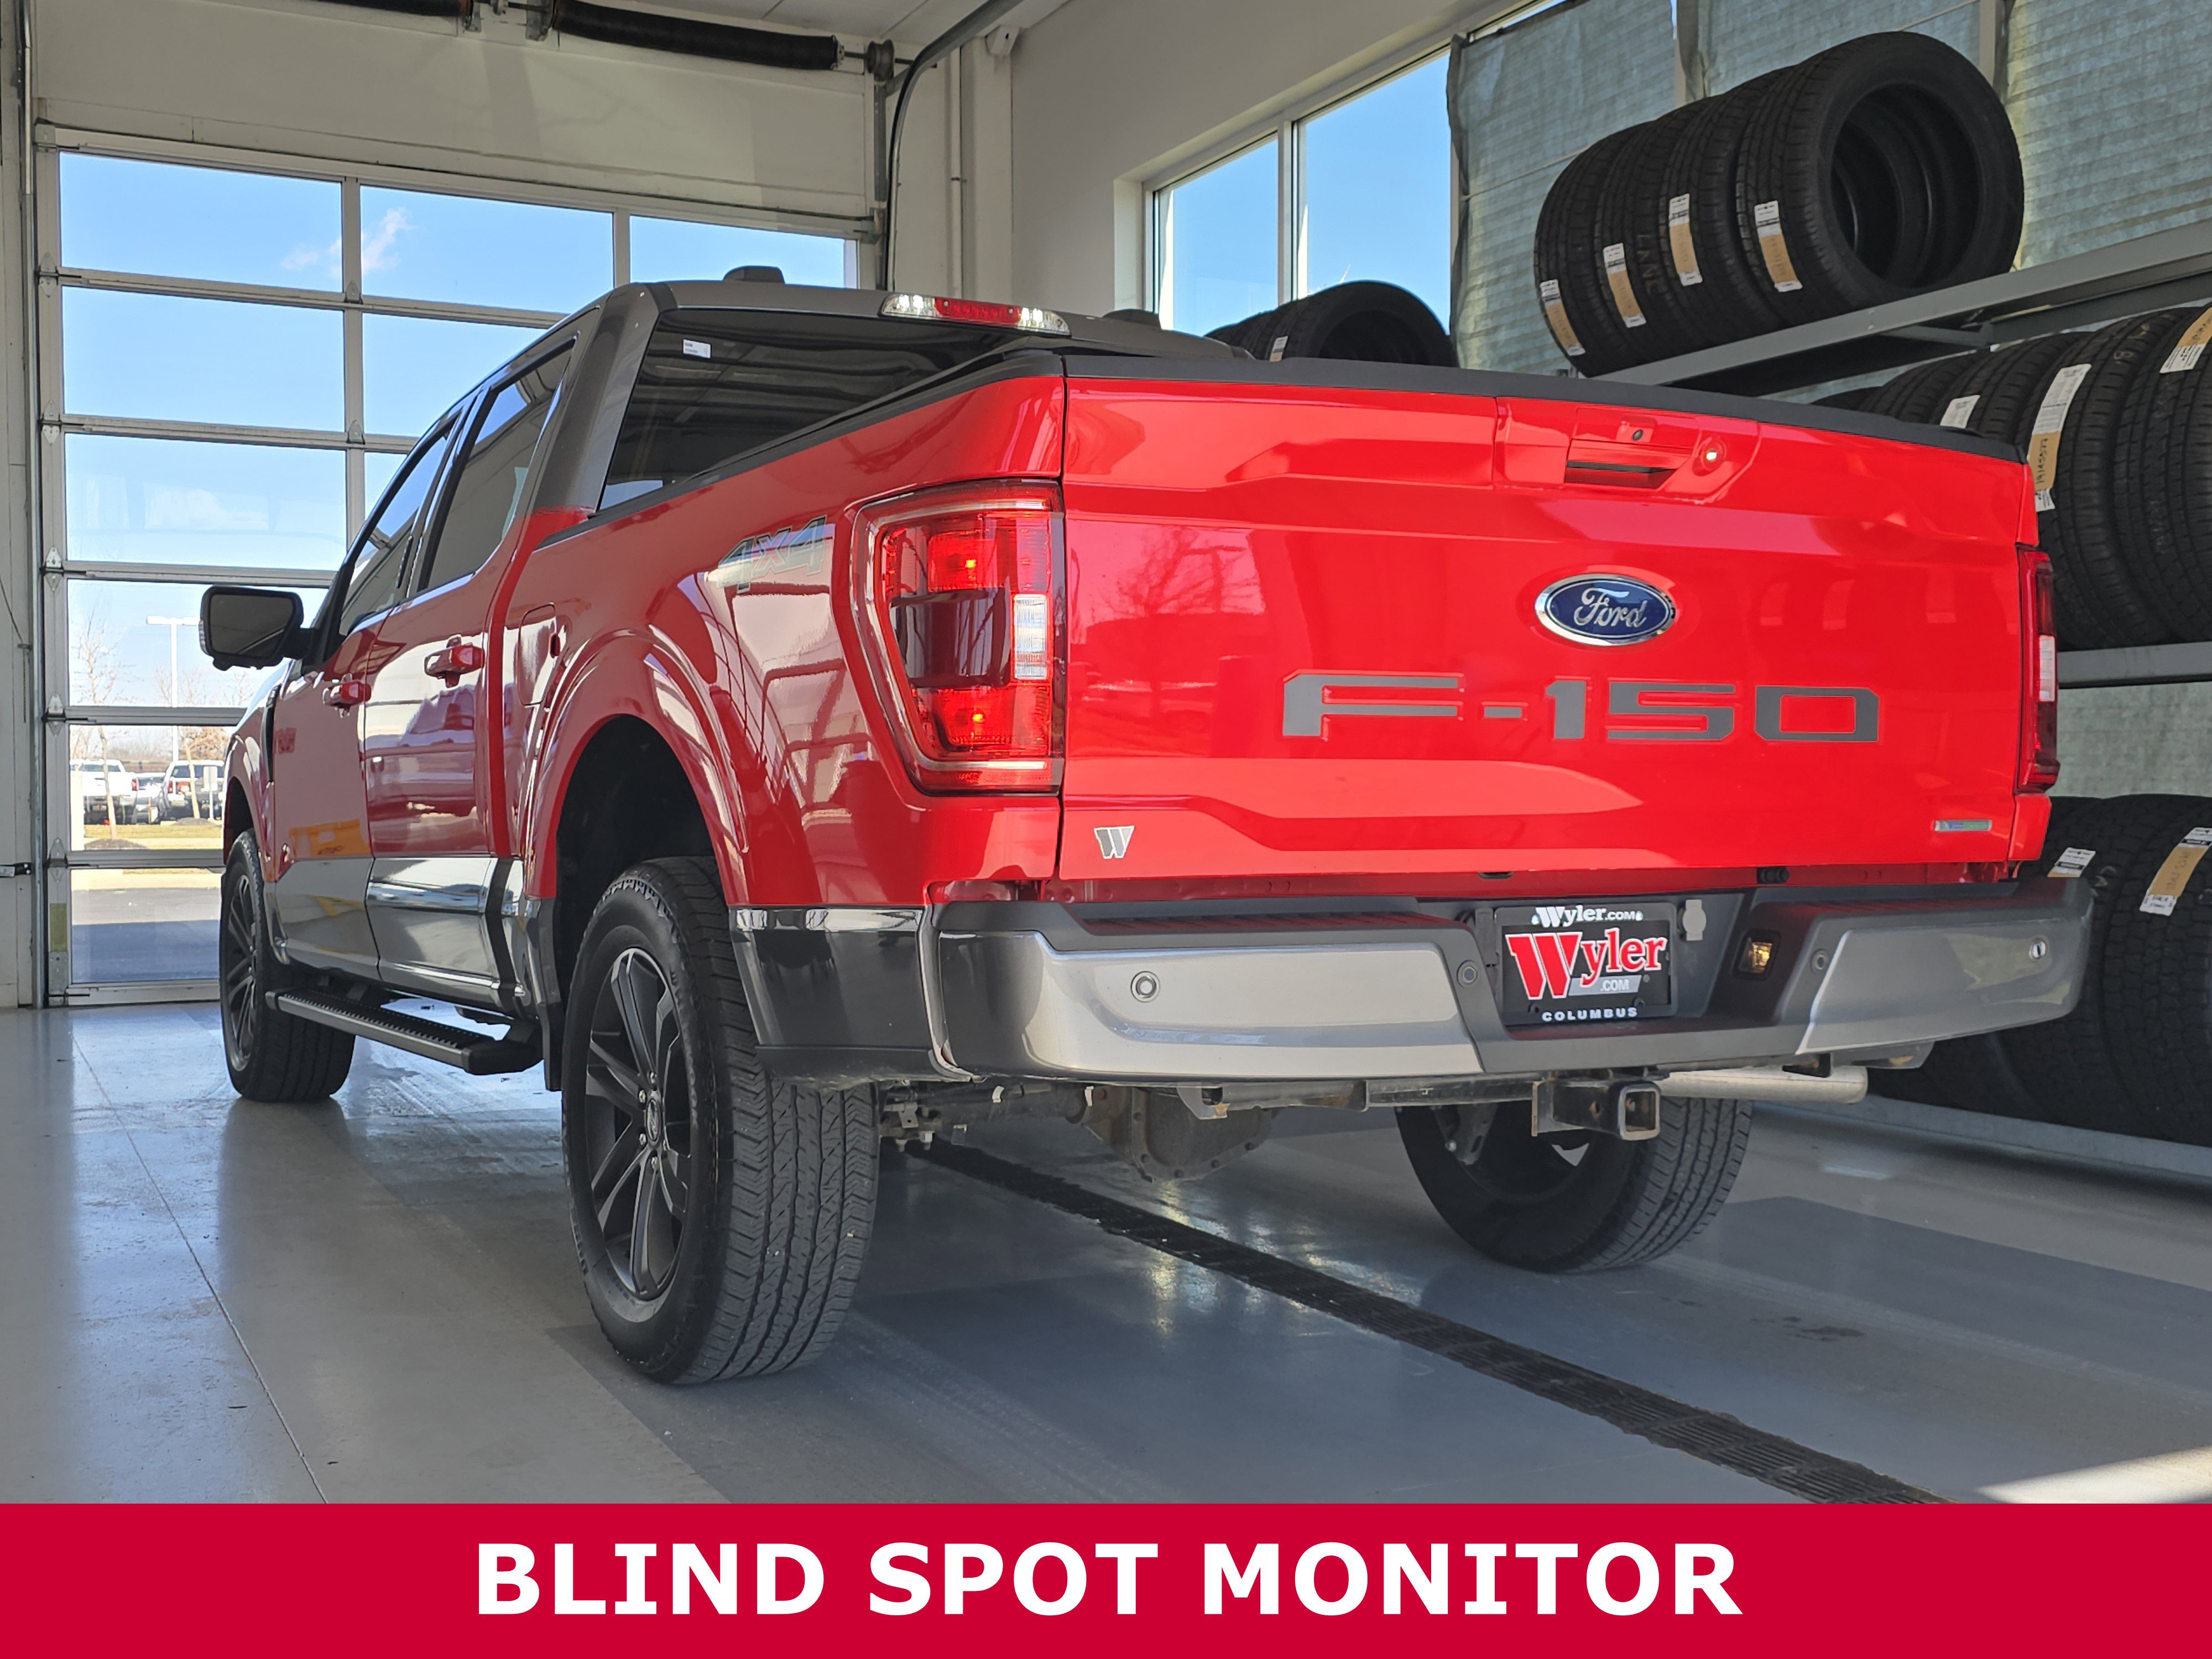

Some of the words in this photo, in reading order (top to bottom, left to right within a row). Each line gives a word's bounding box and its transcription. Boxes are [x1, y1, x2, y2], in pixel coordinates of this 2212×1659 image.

[1574, 587, 1647, 628] Ford
[1281, 674, 1879, 742] F-150
[1505, 927, 1668, 1000] Wyler
[1542, 1007, 1637, 1022] COLUMBUS
